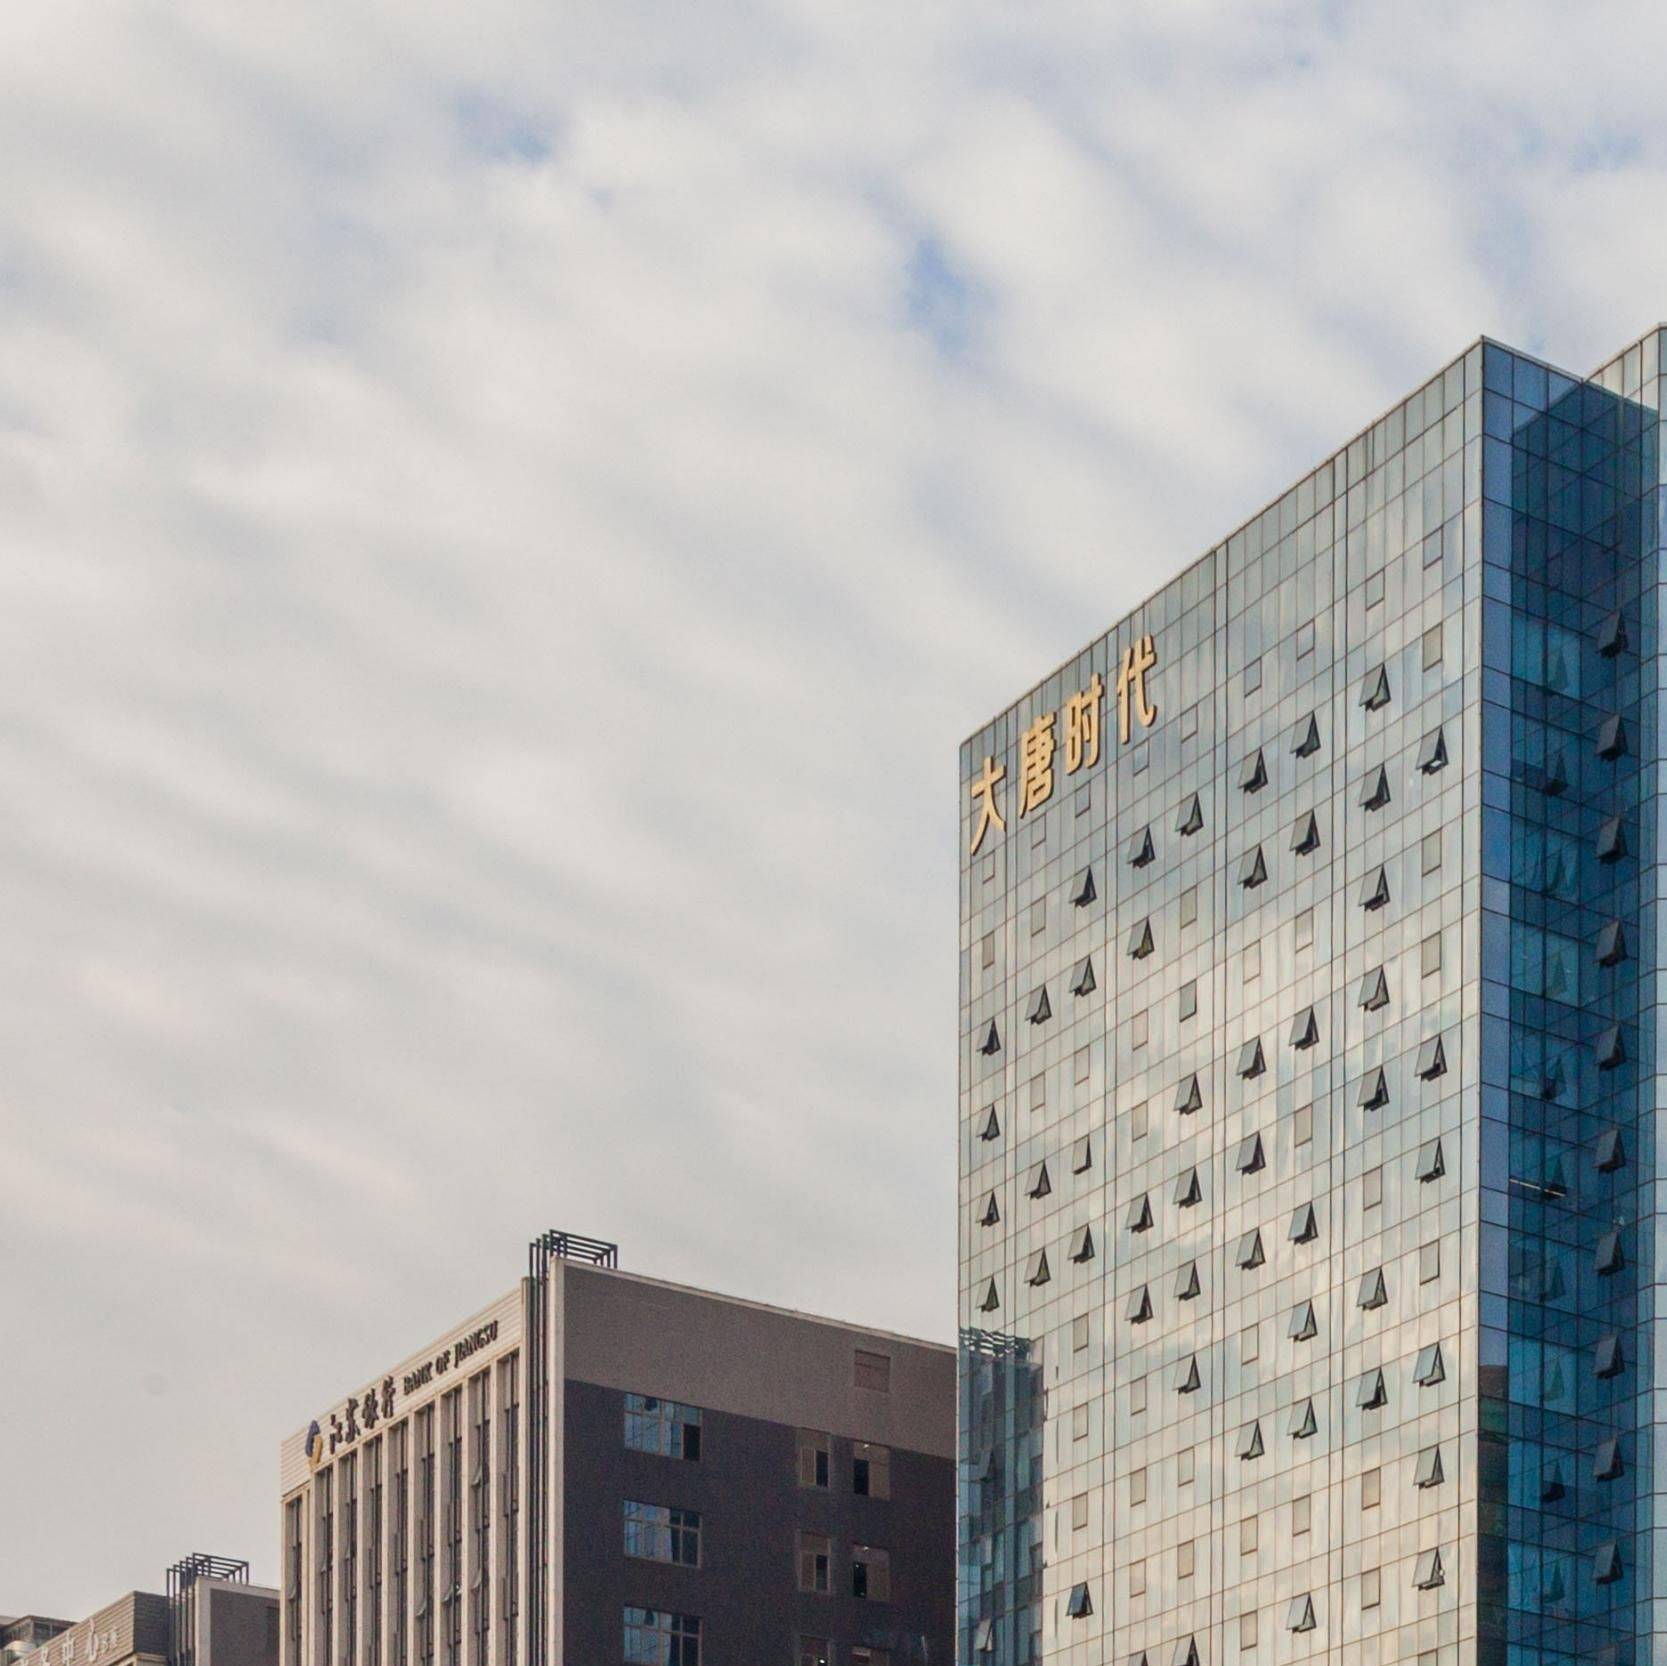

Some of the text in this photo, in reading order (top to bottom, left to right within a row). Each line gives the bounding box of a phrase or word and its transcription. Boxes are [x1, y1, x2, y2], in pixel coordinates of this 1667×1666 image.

[970, 633, 1158, 857] 大唐时代
[402, 1361, 434, 1397] BANK
[435, 1349, 451, 1375] OF
[452, 1319, 499, 1369] JIANGSU
